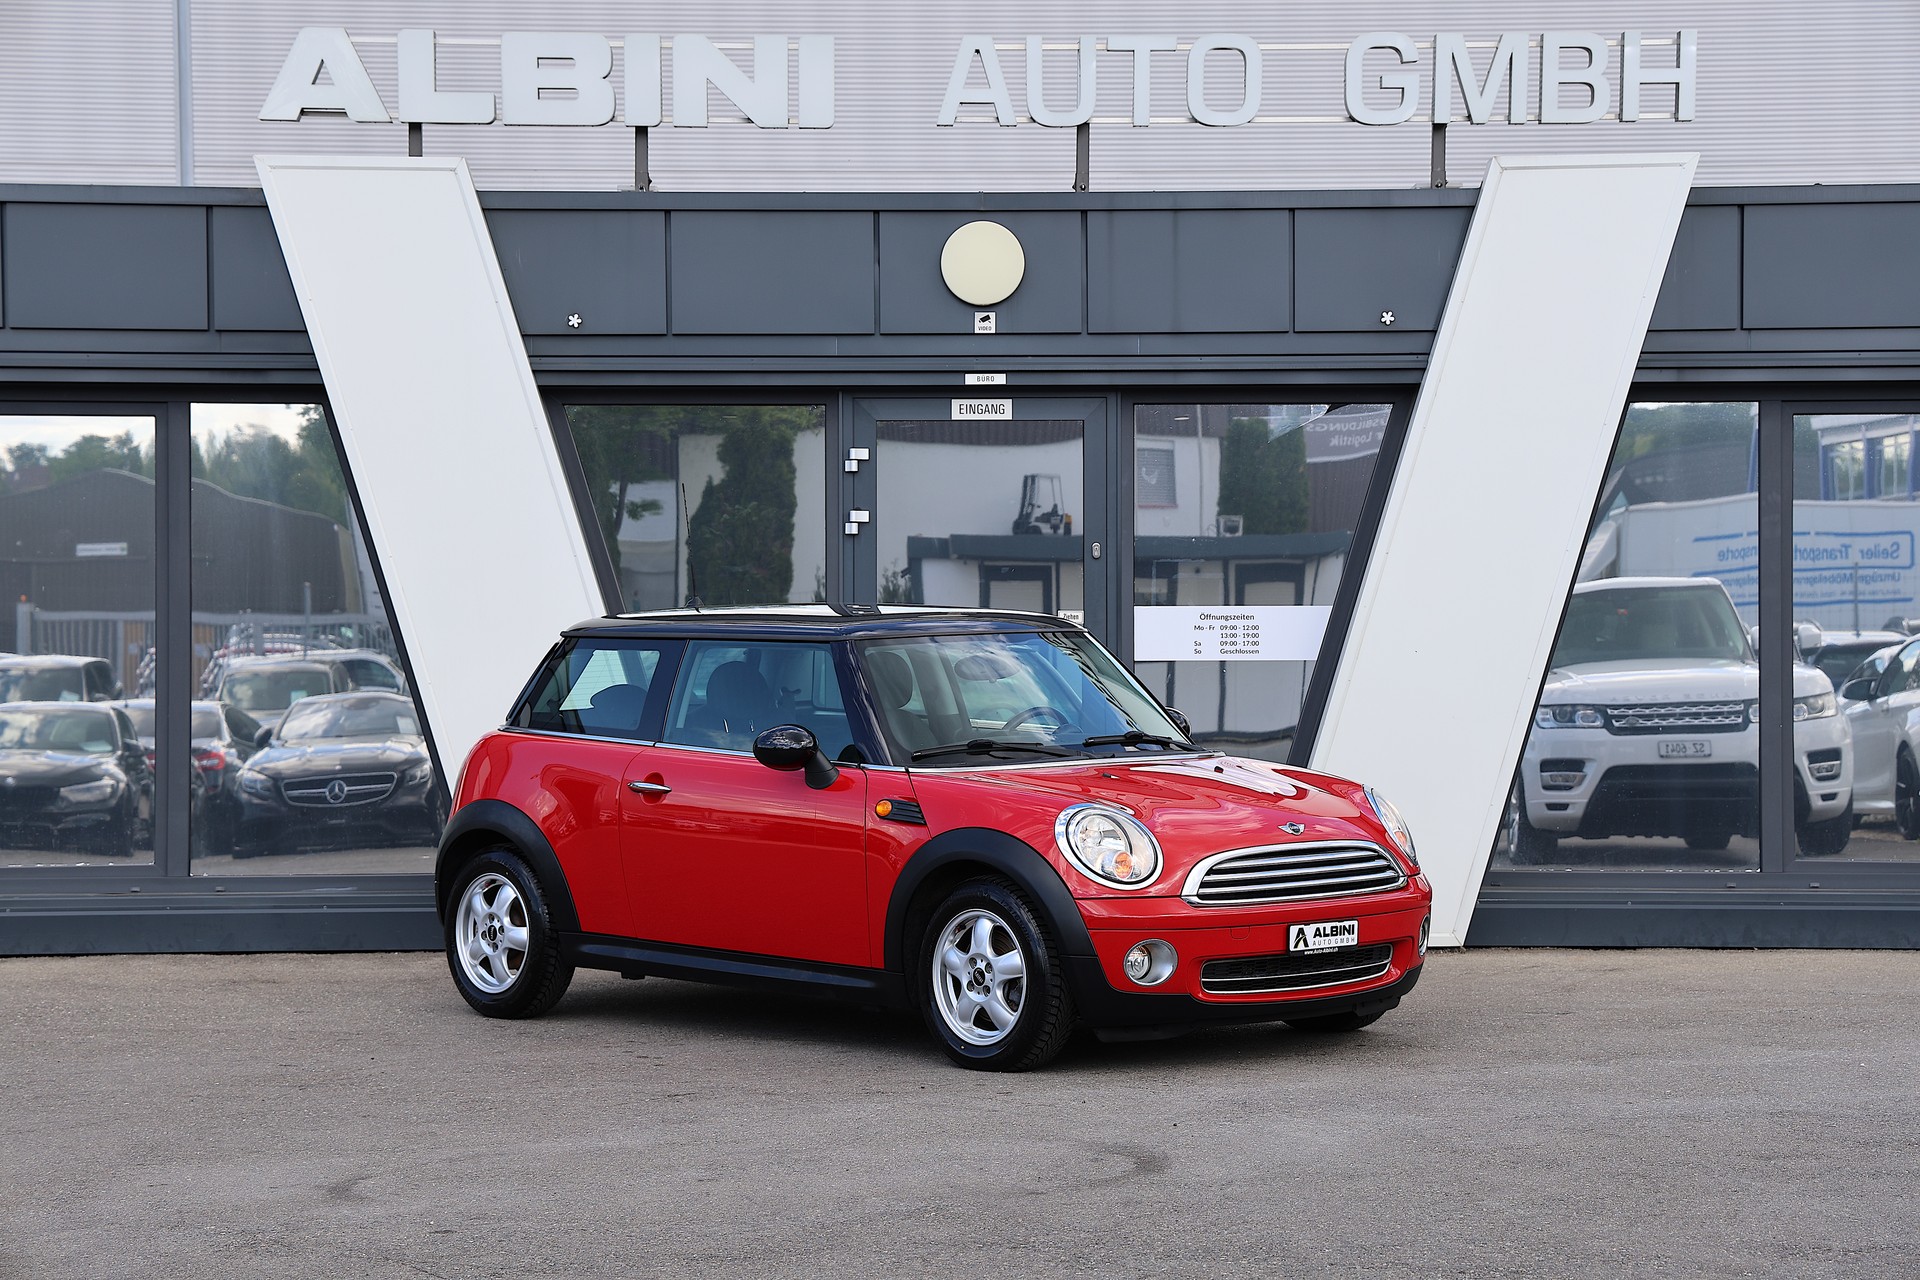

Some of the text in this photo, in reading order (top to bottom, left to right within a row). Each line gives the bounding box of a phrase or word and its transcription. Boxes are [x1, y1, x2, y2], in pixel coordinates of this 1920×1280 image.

[257, 26, 1699, 129] ALBINI AUTO GMBH
[976, 374, 995, 383] BÜRO
[958, 403, 1006, 415] EINGANG
[1199, 612, 1255, 621] Öffnungszeiten
[1312, 924, 1355, 939] ALBINI
[1312, 937, 1355, 947] AUTO GMBH
